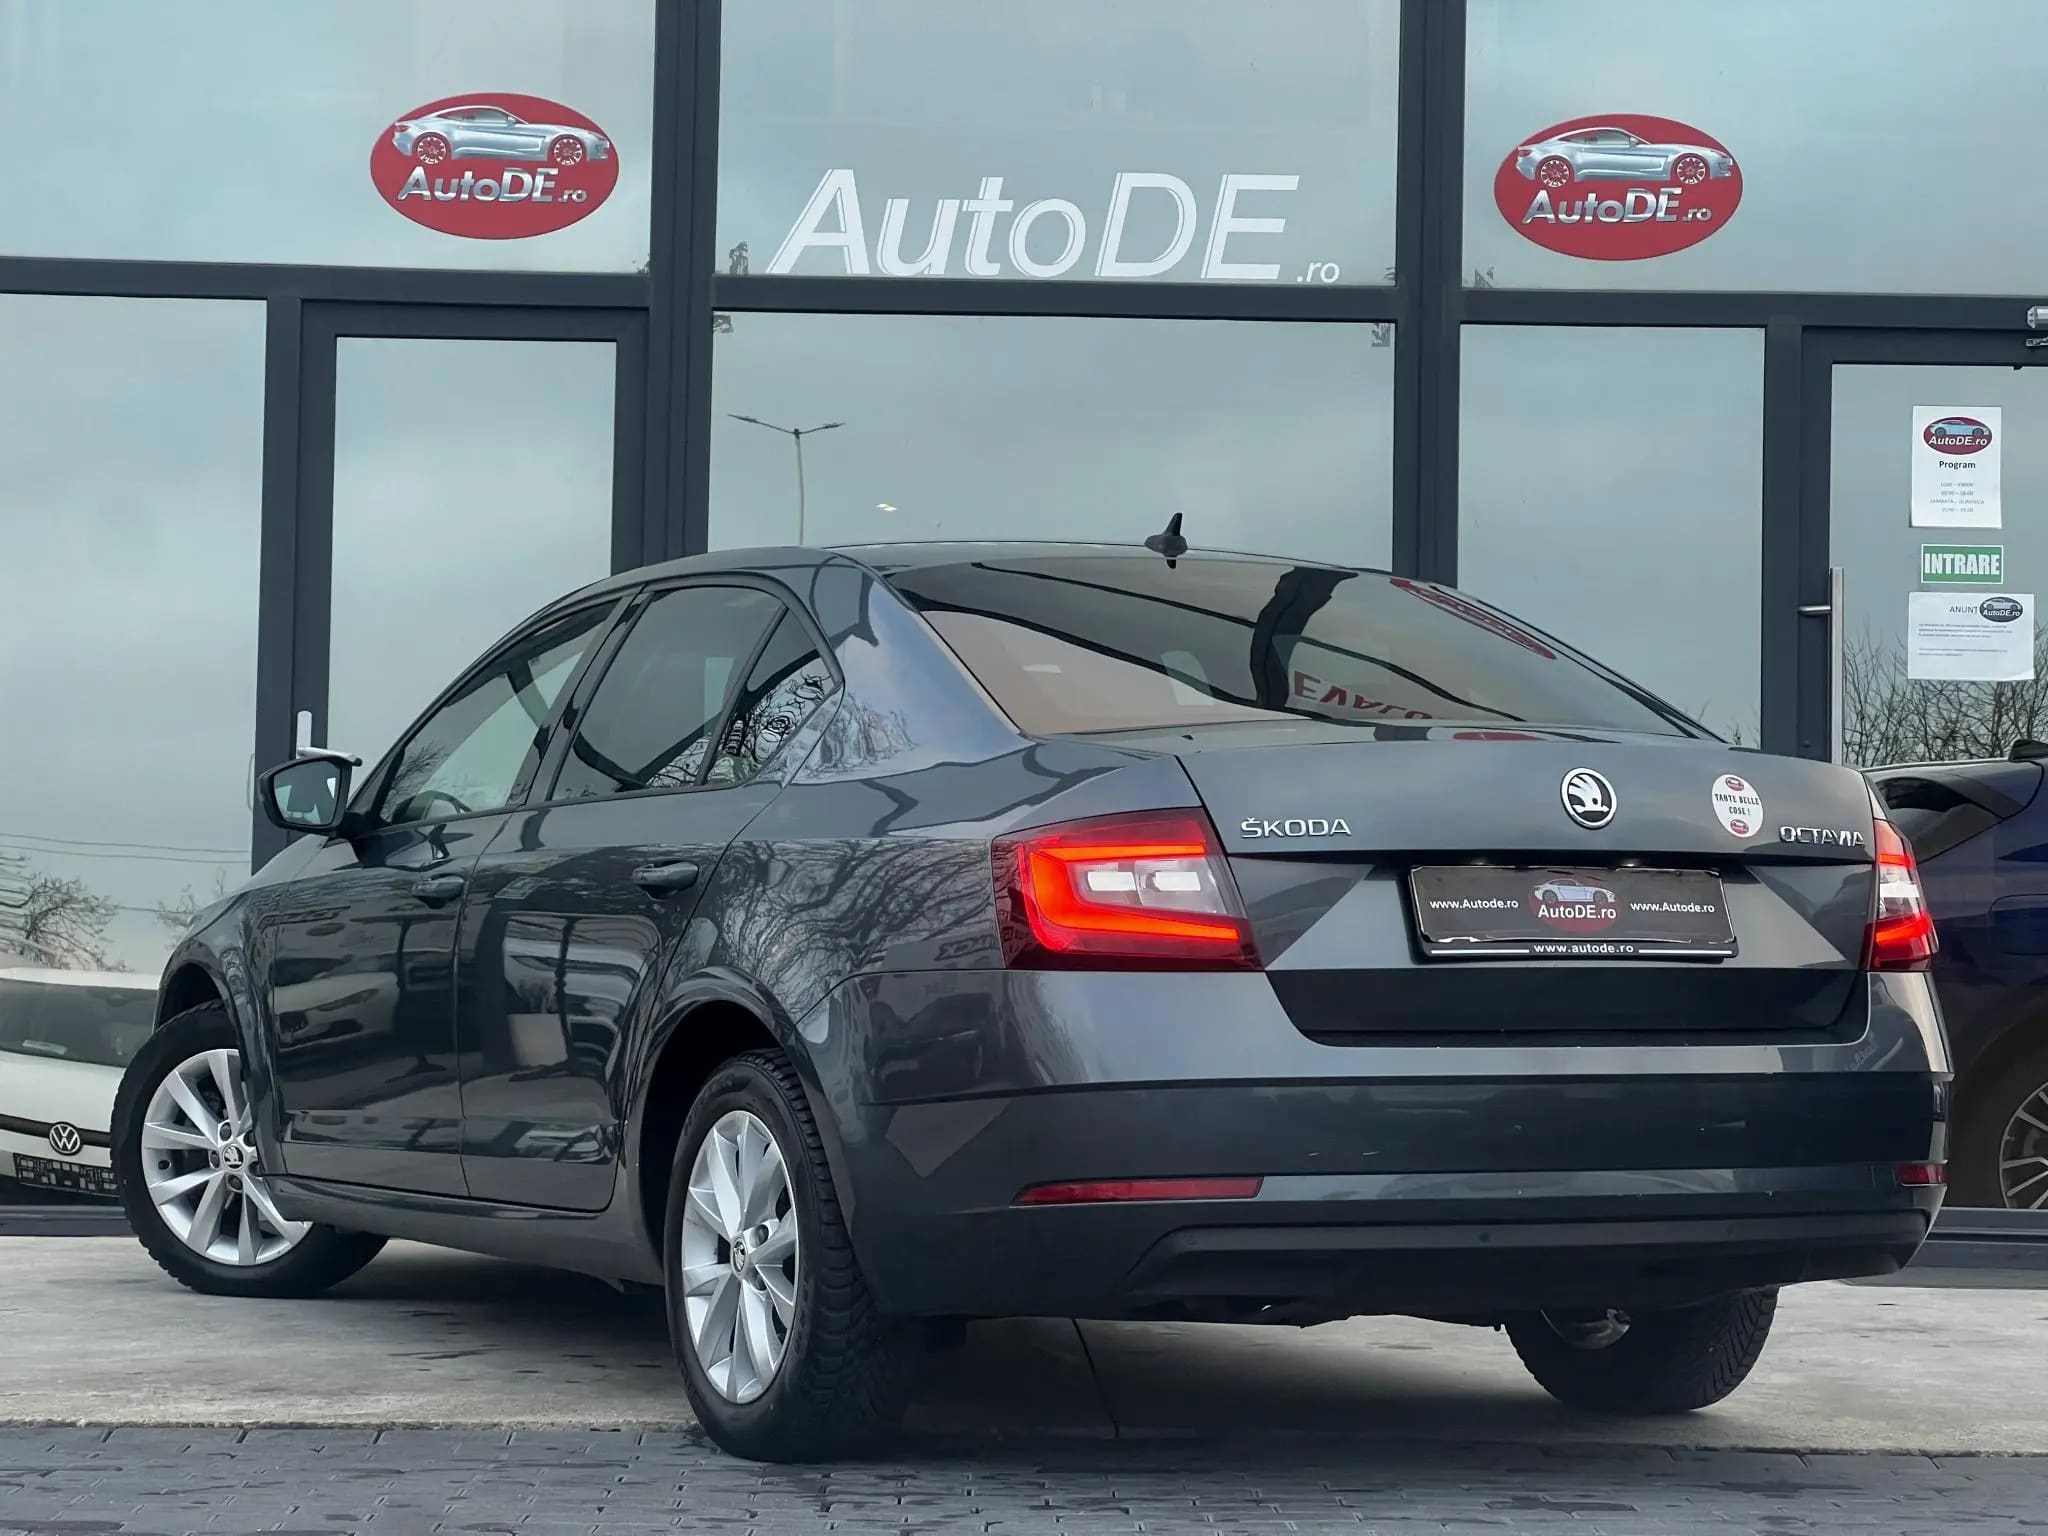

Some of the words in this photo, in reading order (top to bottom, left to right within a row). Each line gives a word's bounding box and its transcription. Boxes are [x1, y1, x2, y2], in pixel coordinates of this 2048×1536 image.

[397, 166, 588, 204] AutoDE.ro
[1522, 187, 1712, 225] AutoDE.ro
[1928, 436, 1988, 446] AutoDE.ro
[1939, 461, 1976, 470] Program
[1924, 553, 2000, 575] INTRARE
[1739, 796, 1760, 805] BELLE
[1728, 806, 1746, 815] COSE
[1240, 817, 1351, 839] ŠKODA
[1780, 826, 1865, 847] OCTAVIA
[1430, 898, 1519, 910] www.Autode.ro
[1630, 901, 1715, 914] www.Autode.ro
[1538, 905, 1617, 920] AutoDE.ro
[1533, 943, 1634, 954] www.autode.ro
